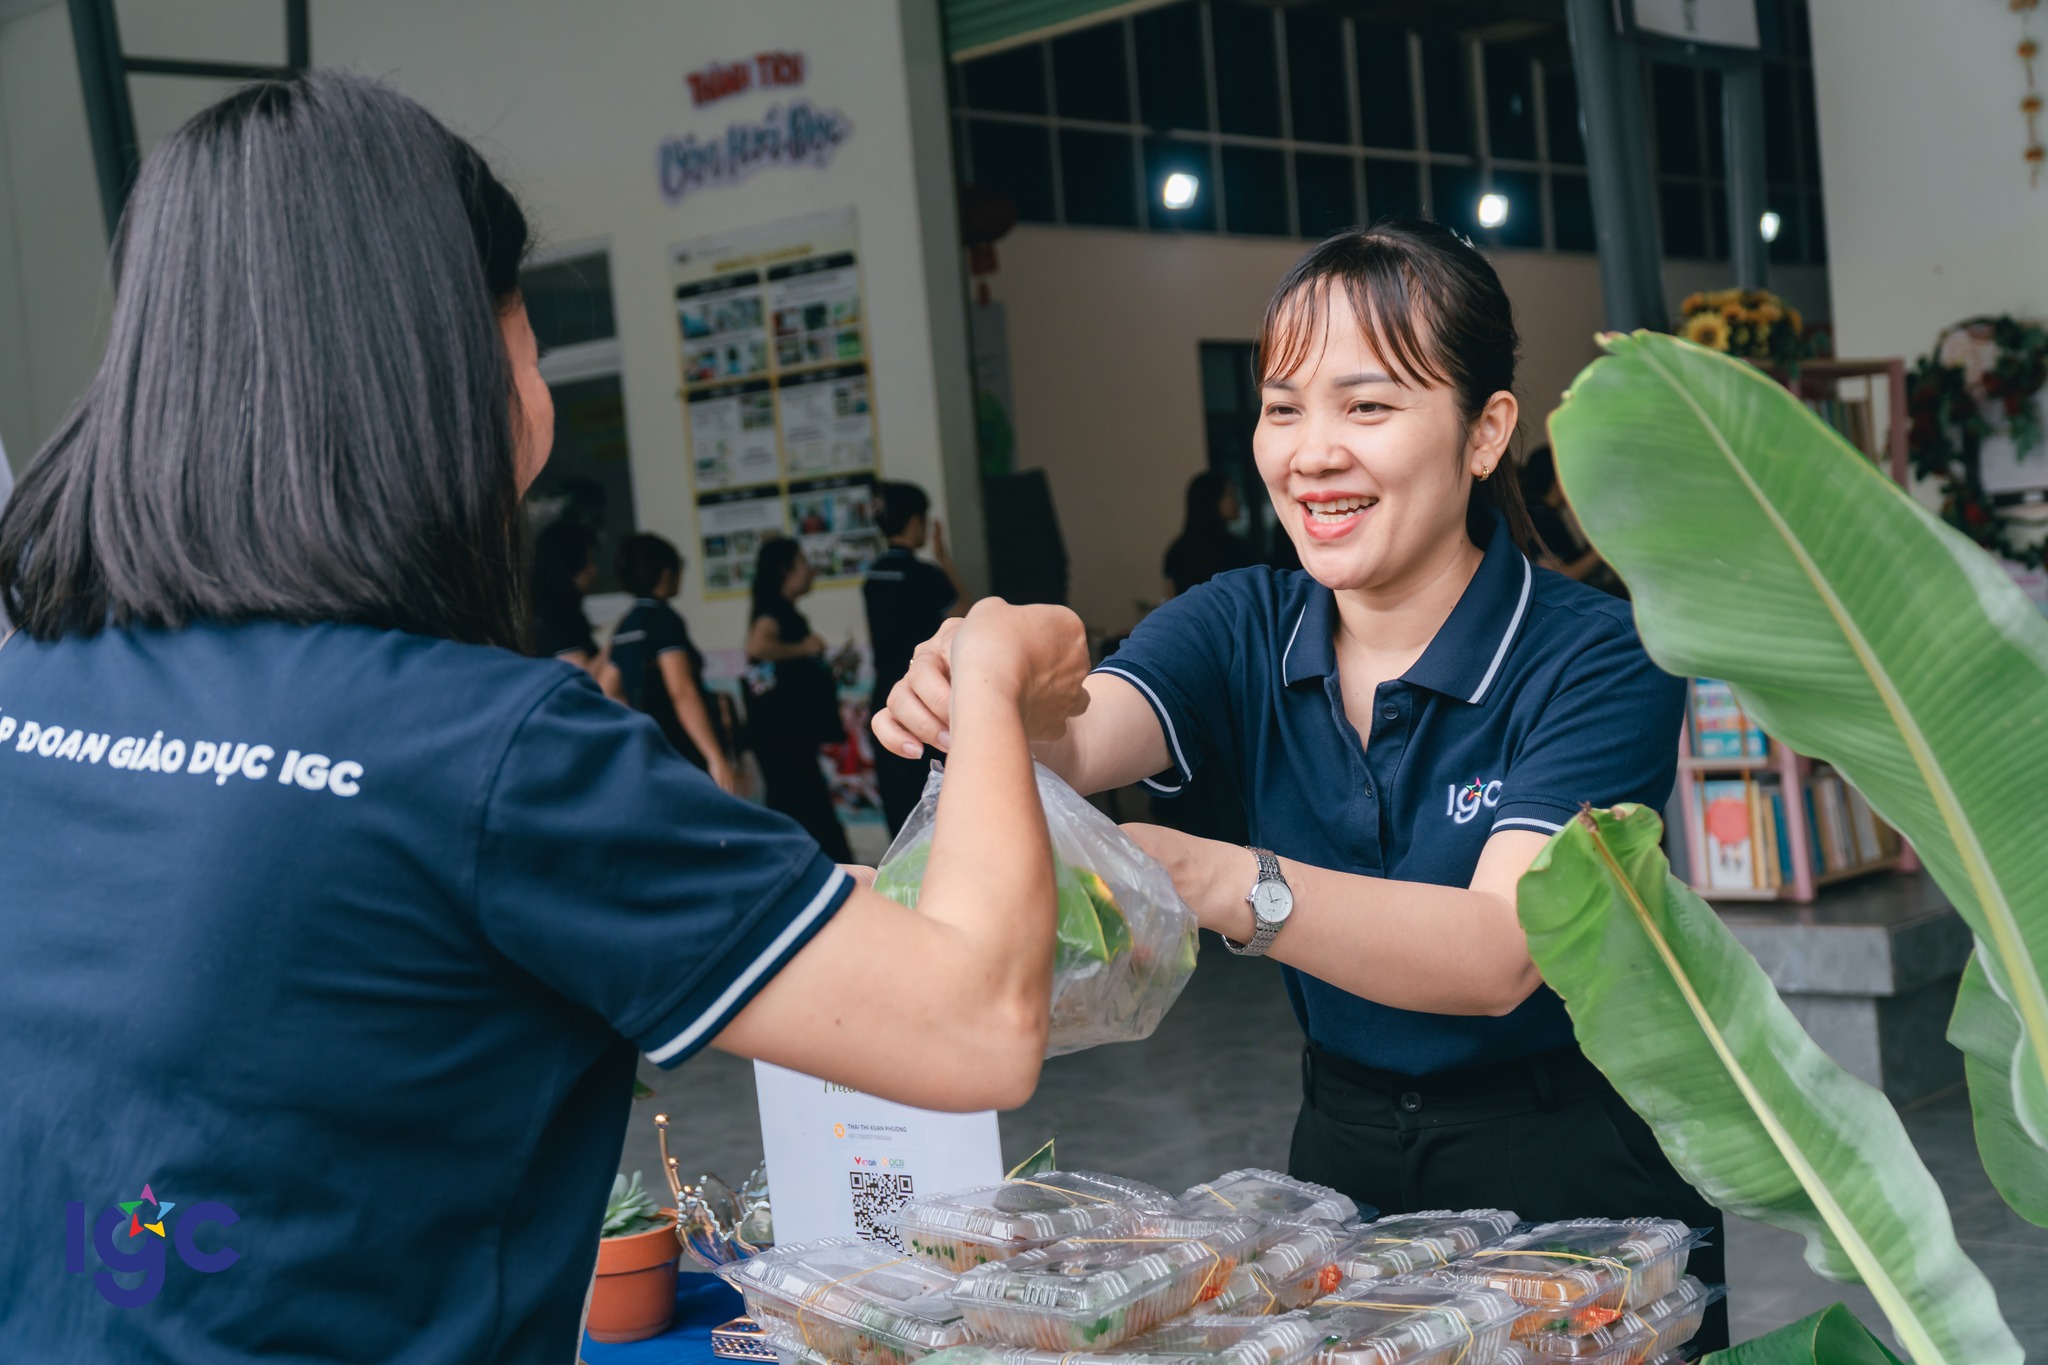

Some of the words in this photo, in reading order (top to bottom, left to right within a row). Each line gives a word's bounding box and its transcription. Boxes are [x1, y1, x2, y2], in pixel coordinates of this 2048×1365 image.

[108, 730, 186, 774] GIÁO
[187, 740, 275, 786] DỤC
[278, 750, 364, 797] IGC
